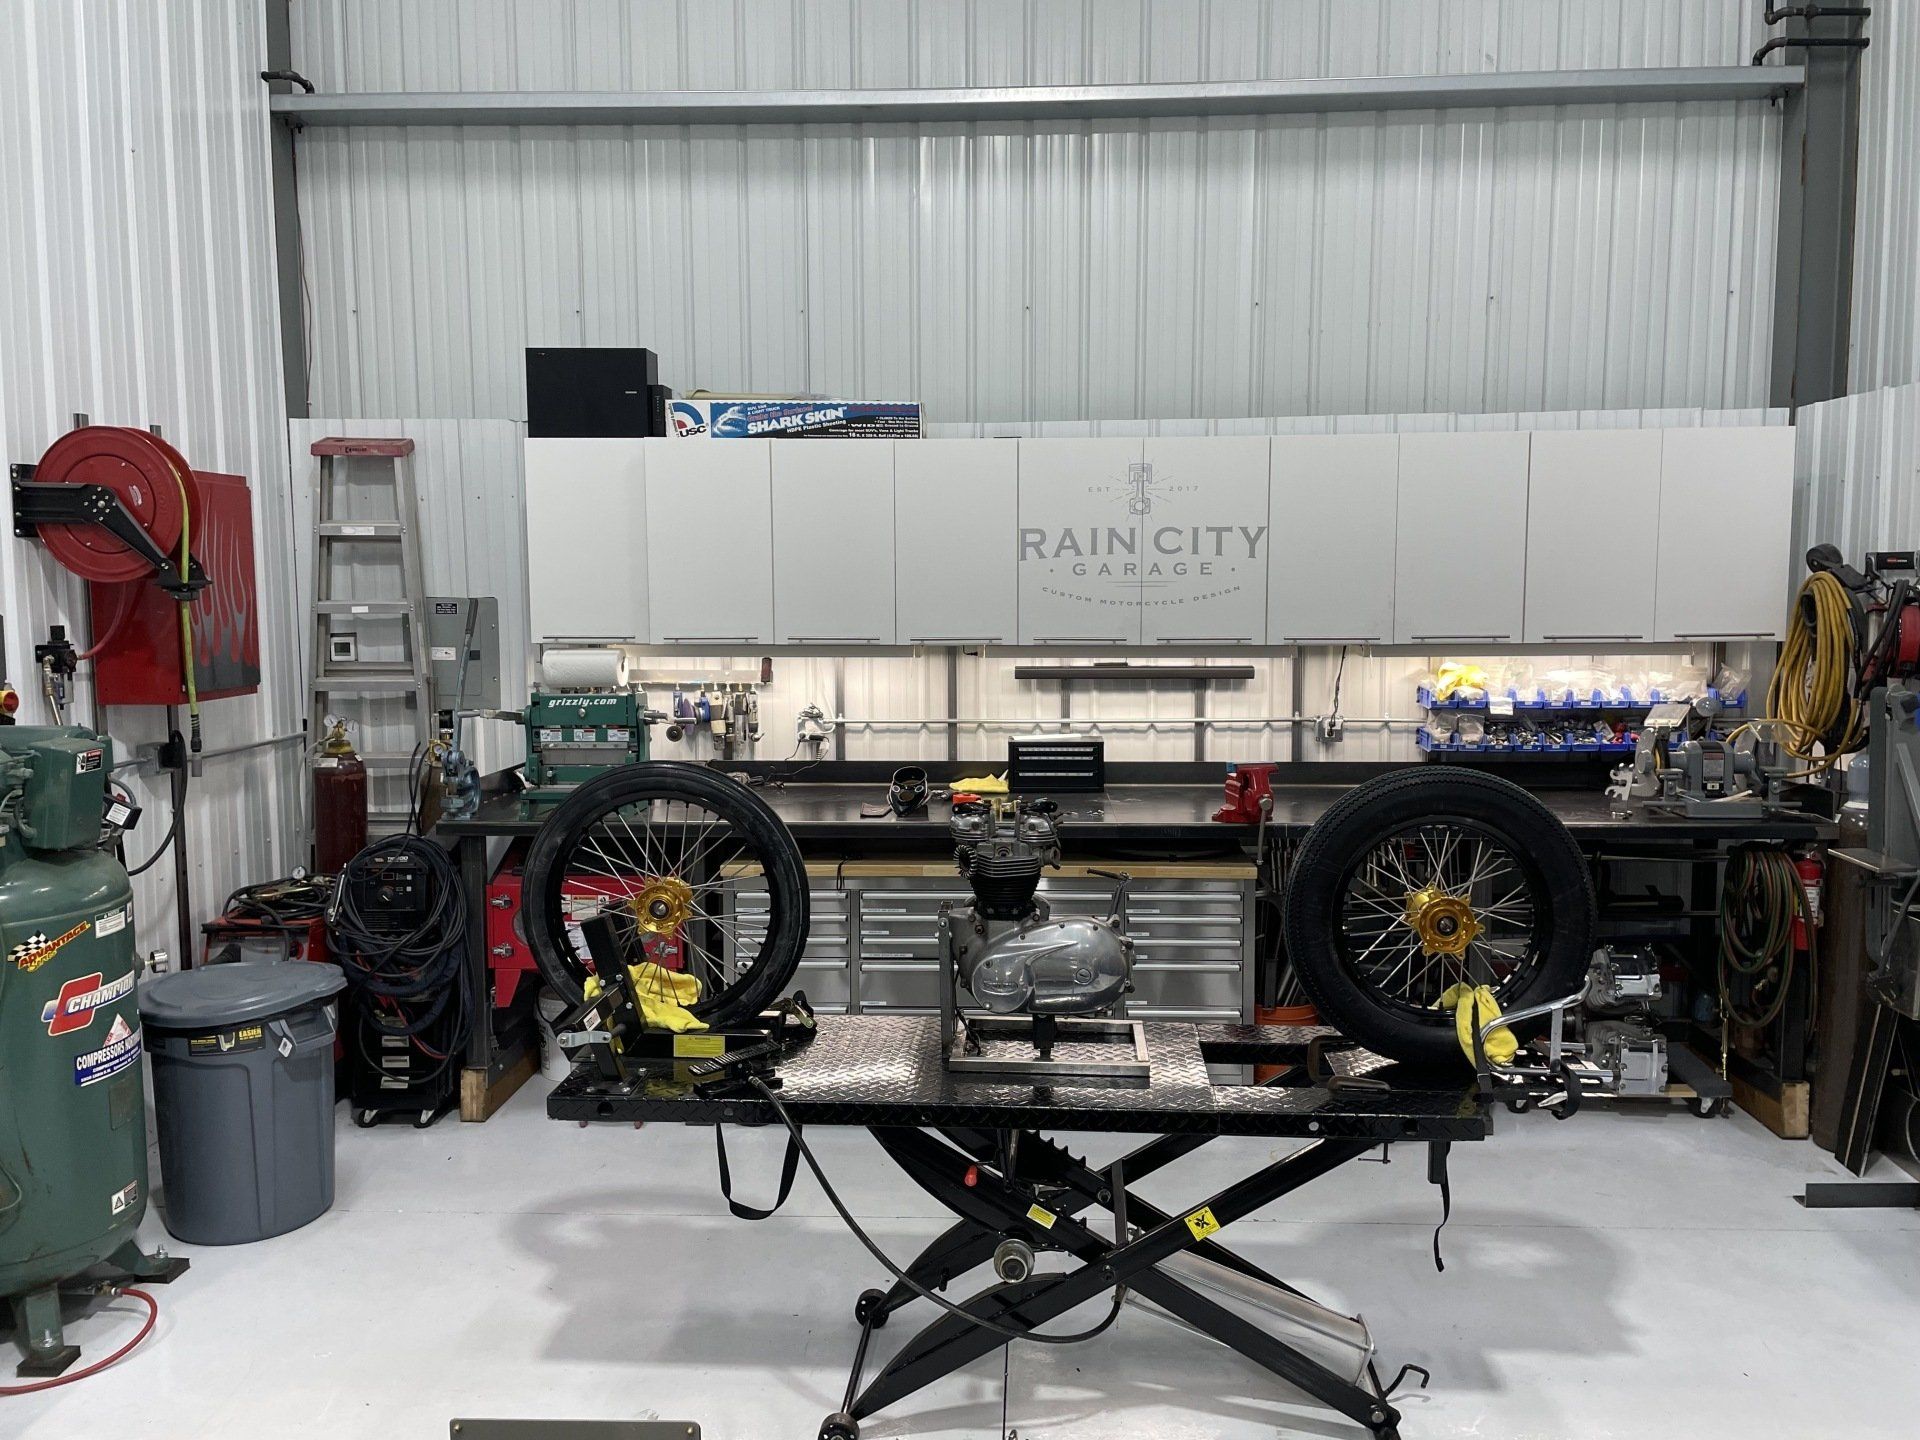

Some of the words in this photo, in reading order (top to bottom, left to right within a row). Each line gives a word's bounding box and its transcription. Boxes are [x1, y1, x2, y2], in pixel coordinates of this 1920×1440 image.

[680, 425, 707, 438] USC
[747, 413, 804, 434] SHARK
[822, 420, 847, 428] Sheeting
[1020, 527, 1137, 562] RAIN
[1153, 526, 1267, 559] CITY
[1072, 562, 1213, 576] GARAGE
[1042, 586, 1092, 602] CUSTOM
[1100, 598, 1184, 606] MOTORCYCLE
[1193, 586, 1240, 602] DESIGN
[548, 697, 617, 708] grizzly.com
[19, 921, 87, 969] ADVANTAGE
[68, 976, 134, 1014] CHAMPION
[76, 1040, 124, 1070] COMPRESSORS
